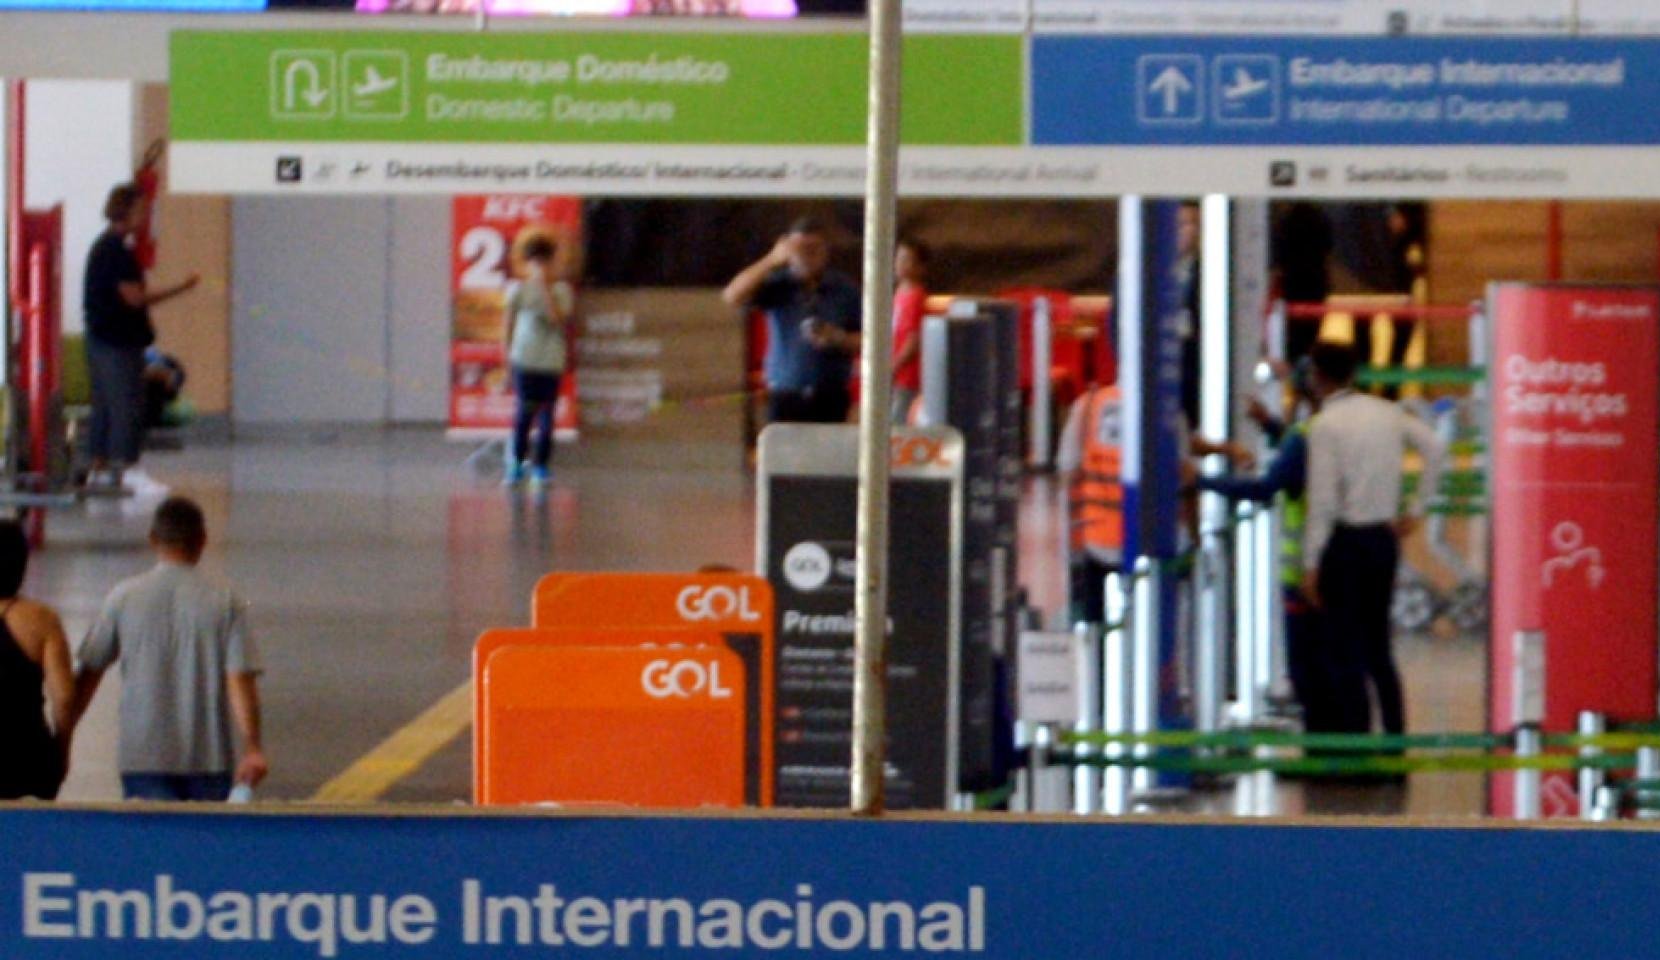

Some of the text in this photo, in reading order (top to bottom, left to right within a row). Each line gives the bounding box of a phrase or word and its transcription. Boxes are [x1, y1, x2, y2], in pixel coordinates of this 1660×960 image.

[426, 51, 729, 86] Embarque Doméstico
[1290, 57, 1625, 88] Embarque Internacional
[426, 93, 675, 125] Domestic Departure
[1290, 96, 1568, 125] International Departure
[1506, 354, 1607, 384] Outros
[1506, 384, 1628, 423] Serviços
[676, 585, 761, 621] GOL
[641, 659, 733, 698] GOL
[23, 872, 985, 958] Embarque Internacional
